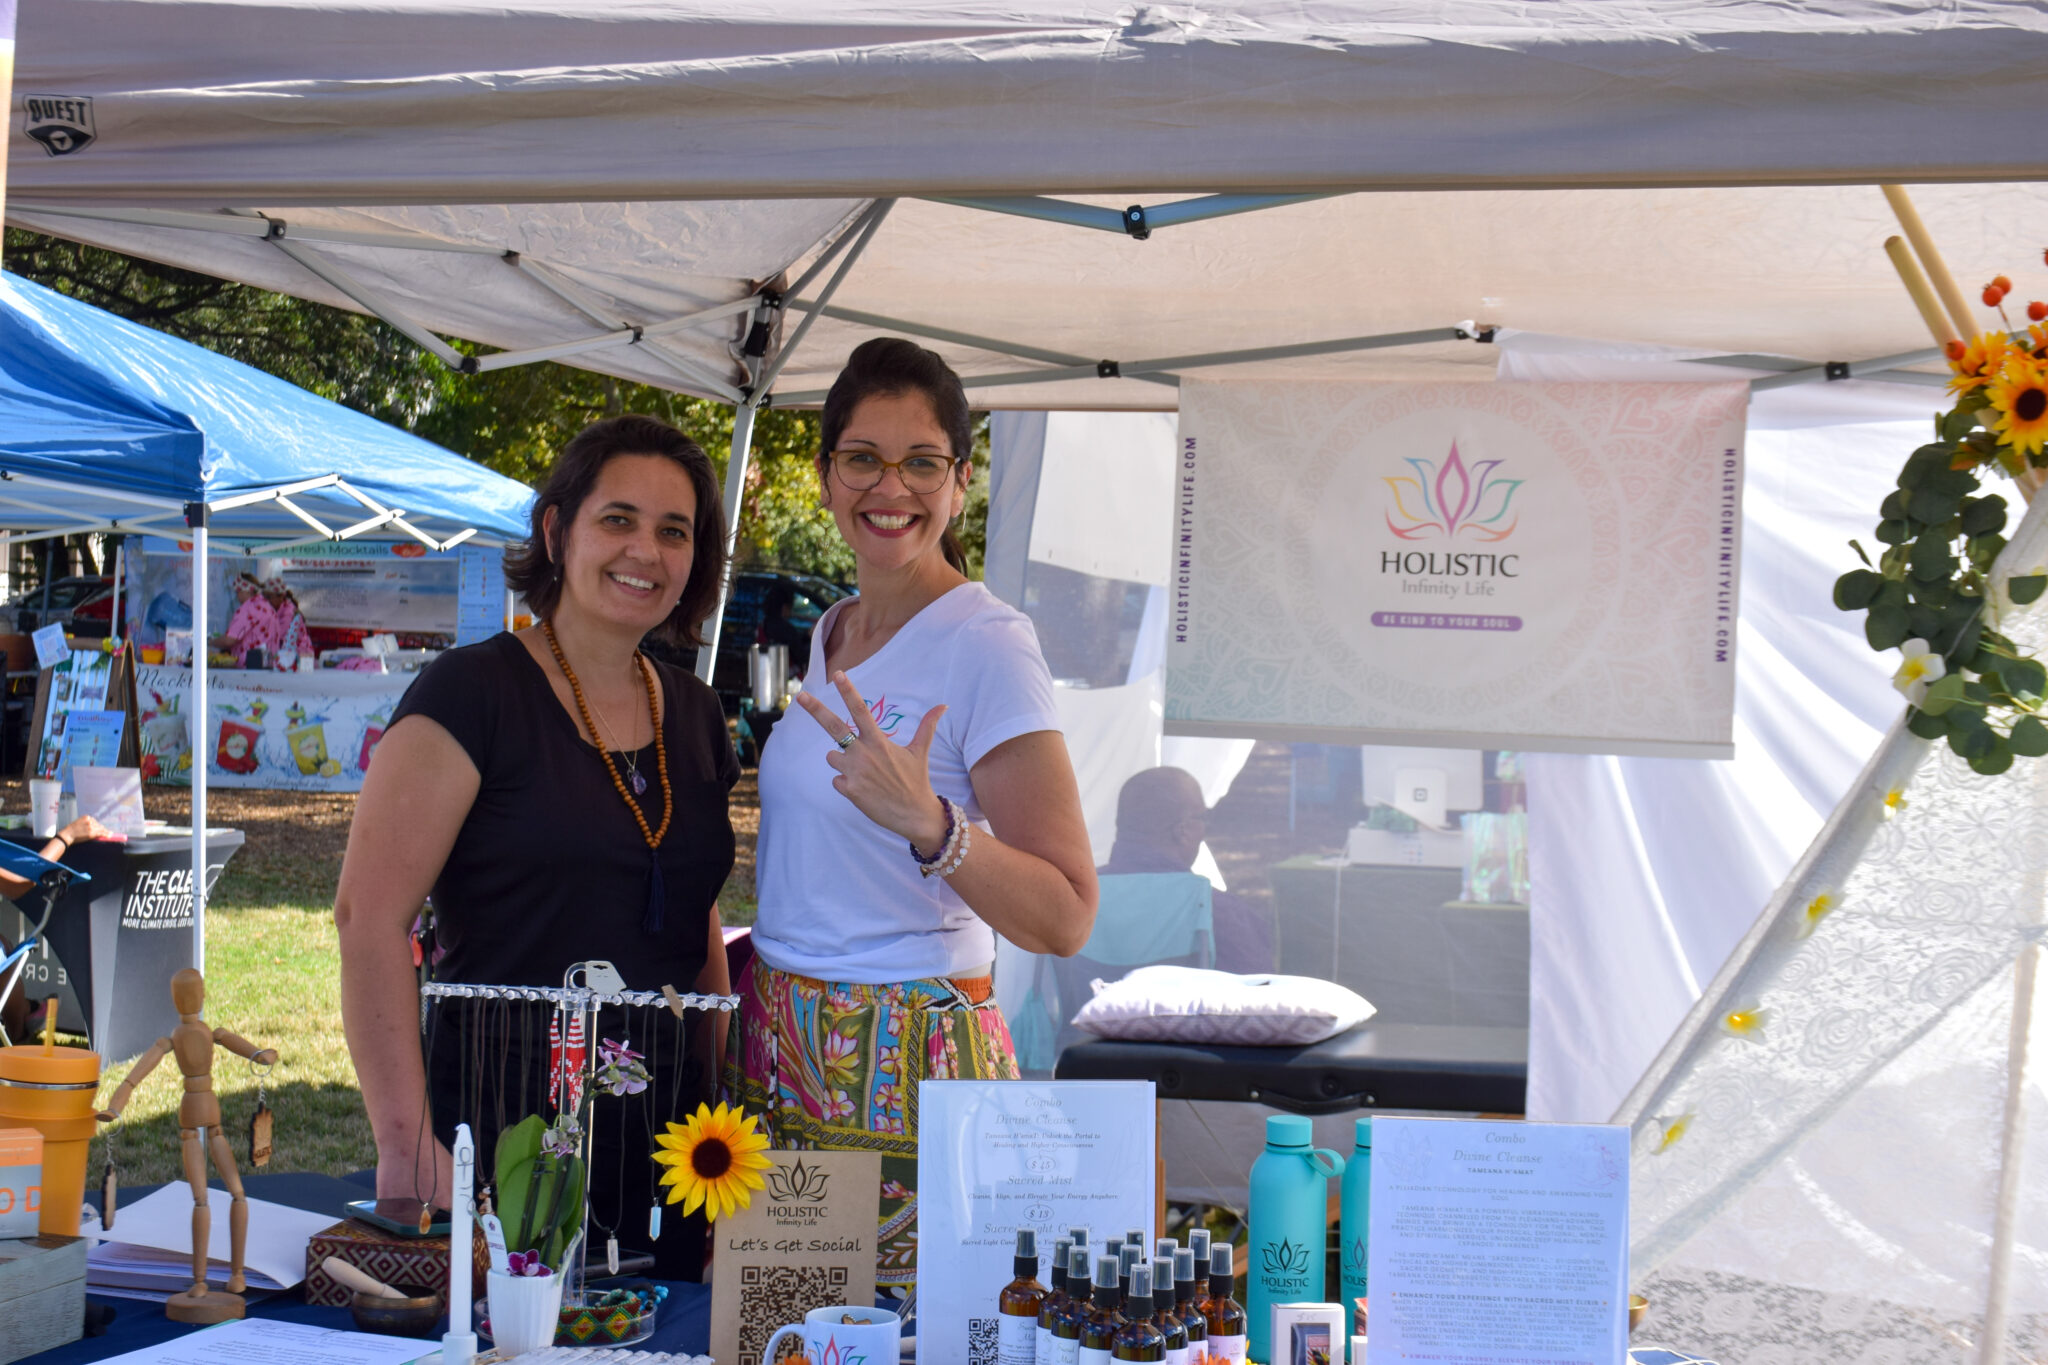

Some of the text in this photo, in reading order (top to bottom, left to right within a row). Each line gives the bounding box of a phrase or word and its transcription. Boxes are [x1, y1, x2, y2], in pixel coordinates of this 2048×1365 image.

[29, 99, 86, 126] QUEST
[1176, 437, 1197, 643] HOLISTICINFINITYLIFE.COM
[329, 543, 389, 556] Mocktails
[1715, 448, 1737, 663] HOLISTICINFINITYLIFE.COM
[1380, 551, 1519, 578] HOLISTIC
[1402, 578, 1495, 600] Infinity Life
[1382, 614, 1511, 628] BE KIND TO YOUR SOUL
[135, 869, 194, 894] THE CLE
[126, 894, 194, 918] INSTITUTE
[122, 917, 139, 929] MORE
[140, 918, 161, 929] CLIMATE
[995, 1114, 1079, 1125] Divine Cleanse
[1485, 1132, 1526, 1144] Combo
[1452, 1149, 1543, 1164] Divine Cleanse
[1007, 1175, 1073, 1186] Sacred Mist
[767, 1206, 829, 1218] HOLISTIC
[776, 1218, 818, 1228] Infinity Life
[729, 1236, 862, 1254] Let's Get Social
[1261, 1275, 1310, 1288] HOLISTIC
[1268, 1287, 1302, 1296] Infinity Life
